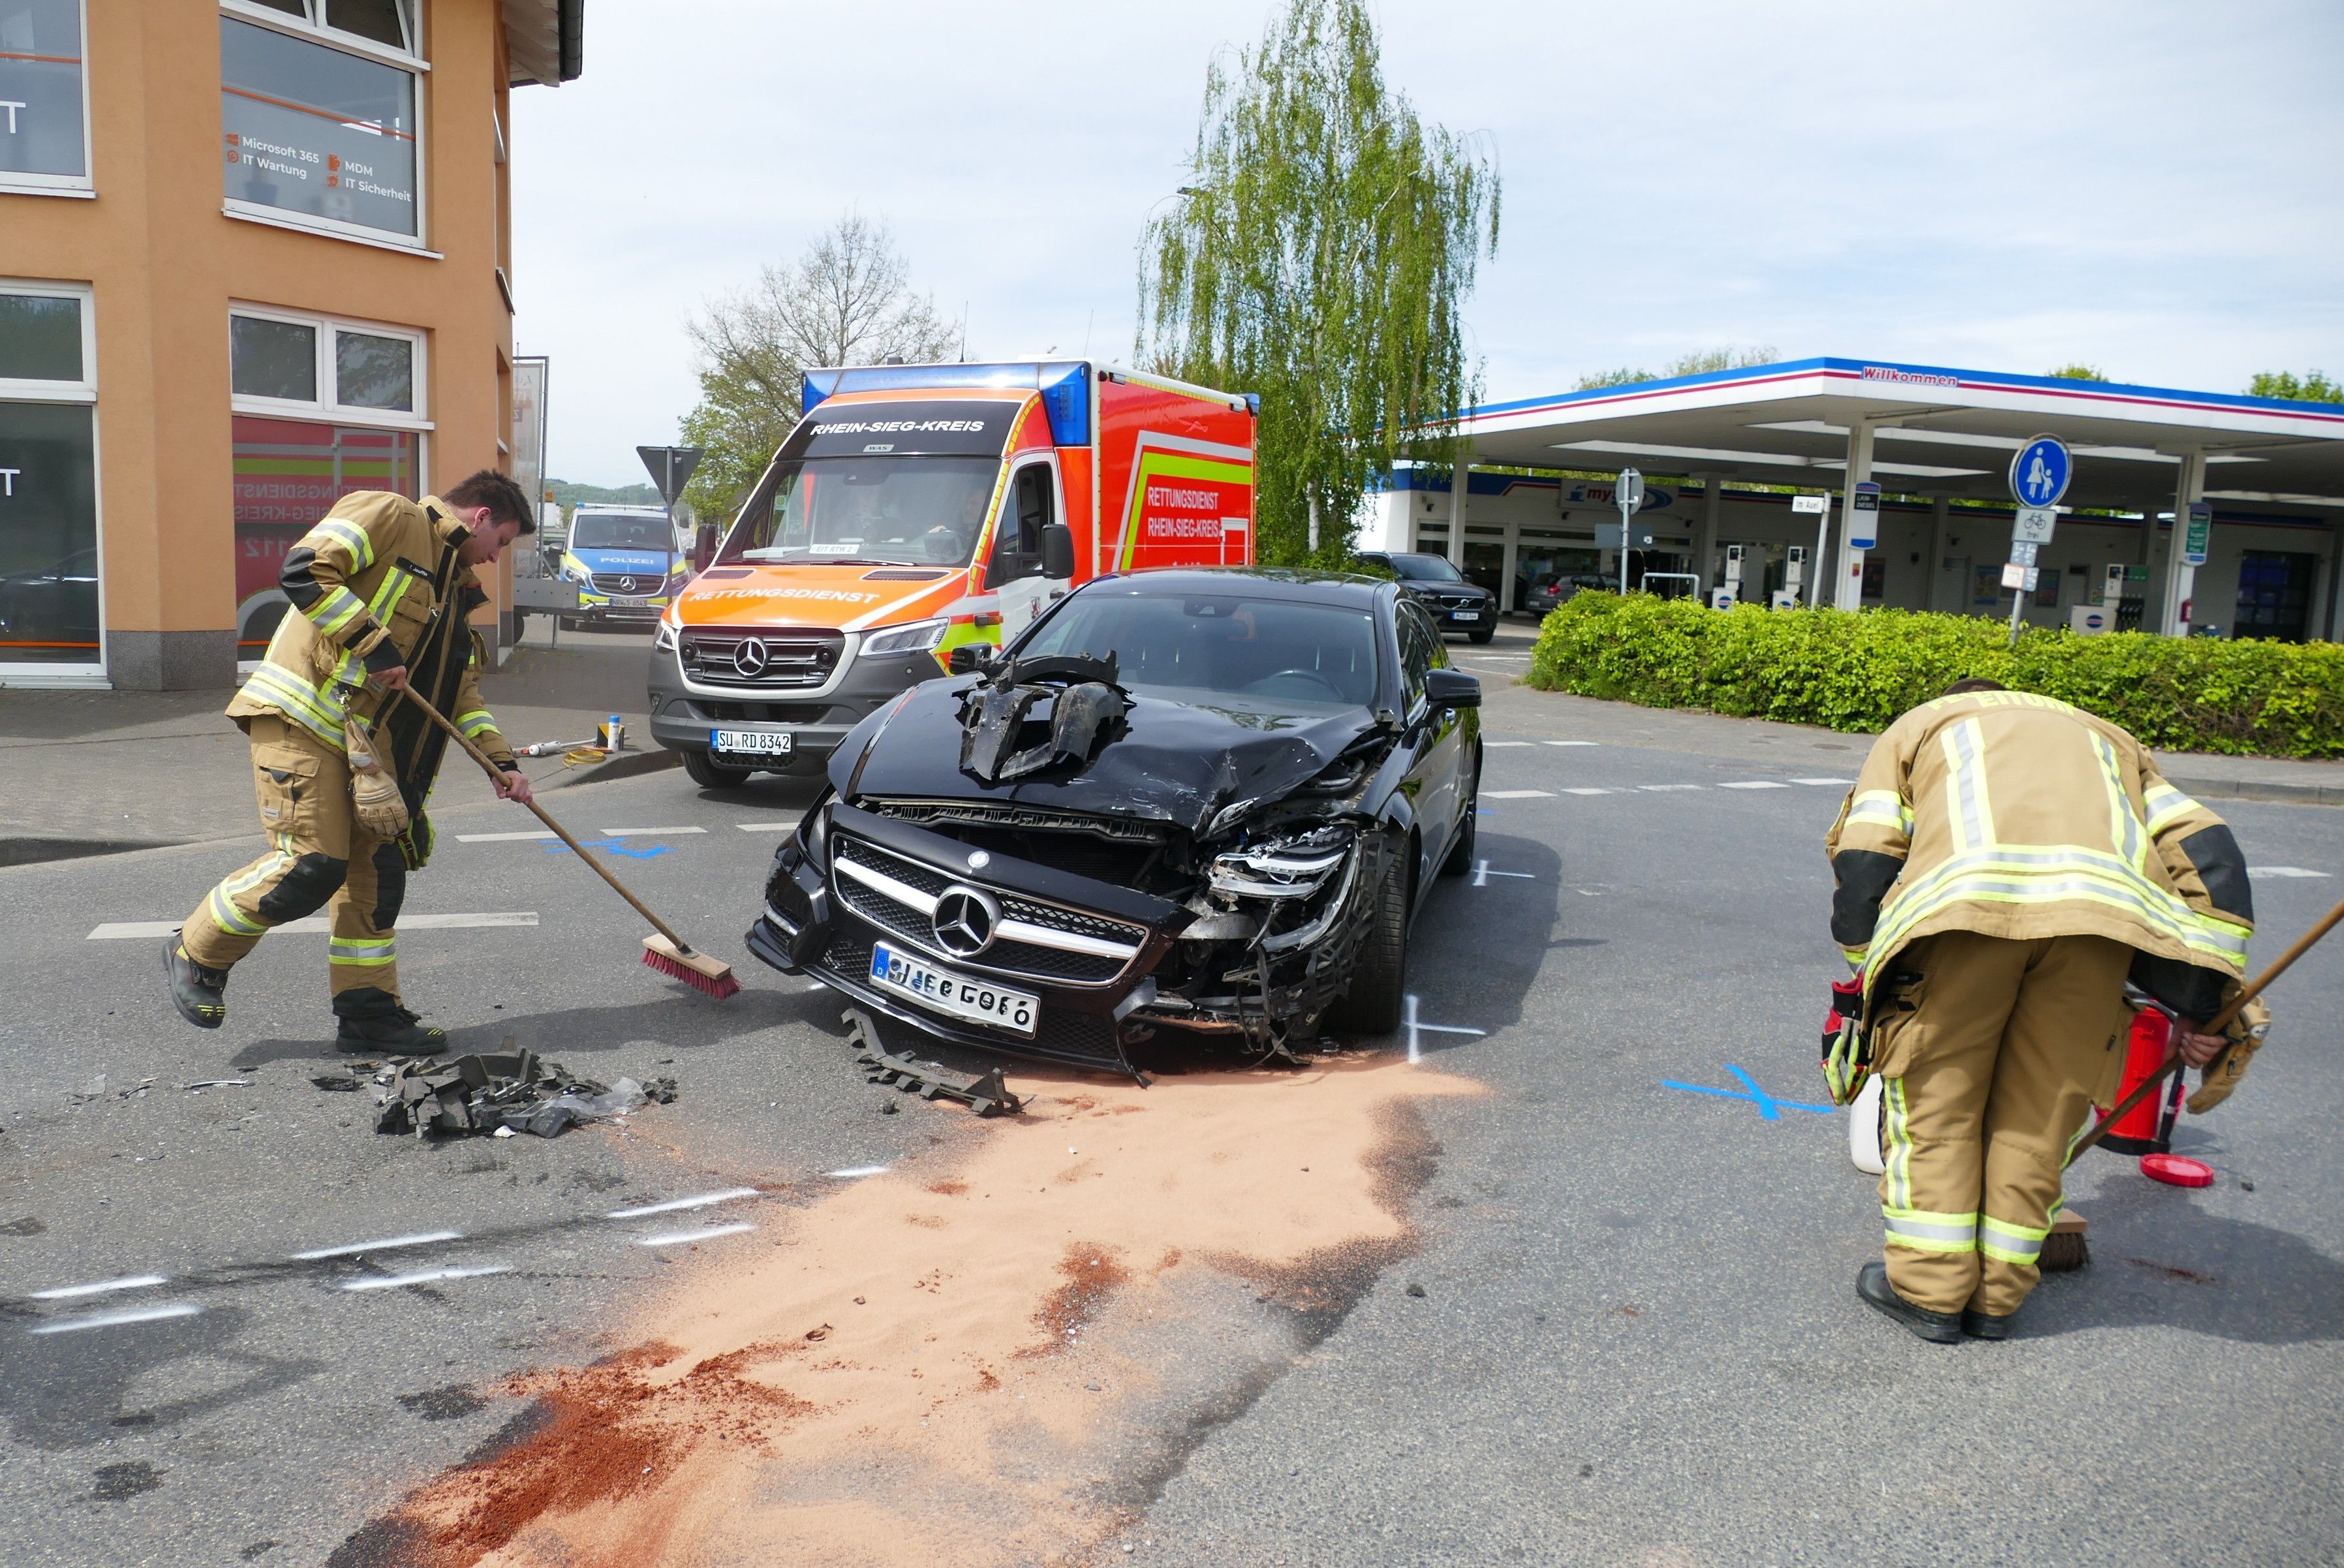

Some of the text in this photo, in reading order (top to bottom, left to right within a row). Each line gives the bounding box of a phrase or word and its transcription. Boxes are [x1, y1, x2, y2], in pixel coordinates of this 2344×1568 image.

[242, 136, 319, 164] Microsoft 365
[243, 154, 307, 180] IT Wartung
[345, 161, 373, 177] MDM
[345, 177, 412, 202] IT Sicherheit
[1864, 367, 1956, 386] Willkommen
[810, 420, 985, 436] RHEIN-SIEG-KREIS
[1147, 486, 1220, 510] RETTUNGSDIENST
[1147, 517, 1219, 538] RHEIN-SIEG-KREIS
[2028, 530, 2039, 539] frei
[689, 588, 880, 604] RETTUNGSDIENST
[719, 733, 790, 750] SU RD 8342
[876, 966, 883, 976] D
